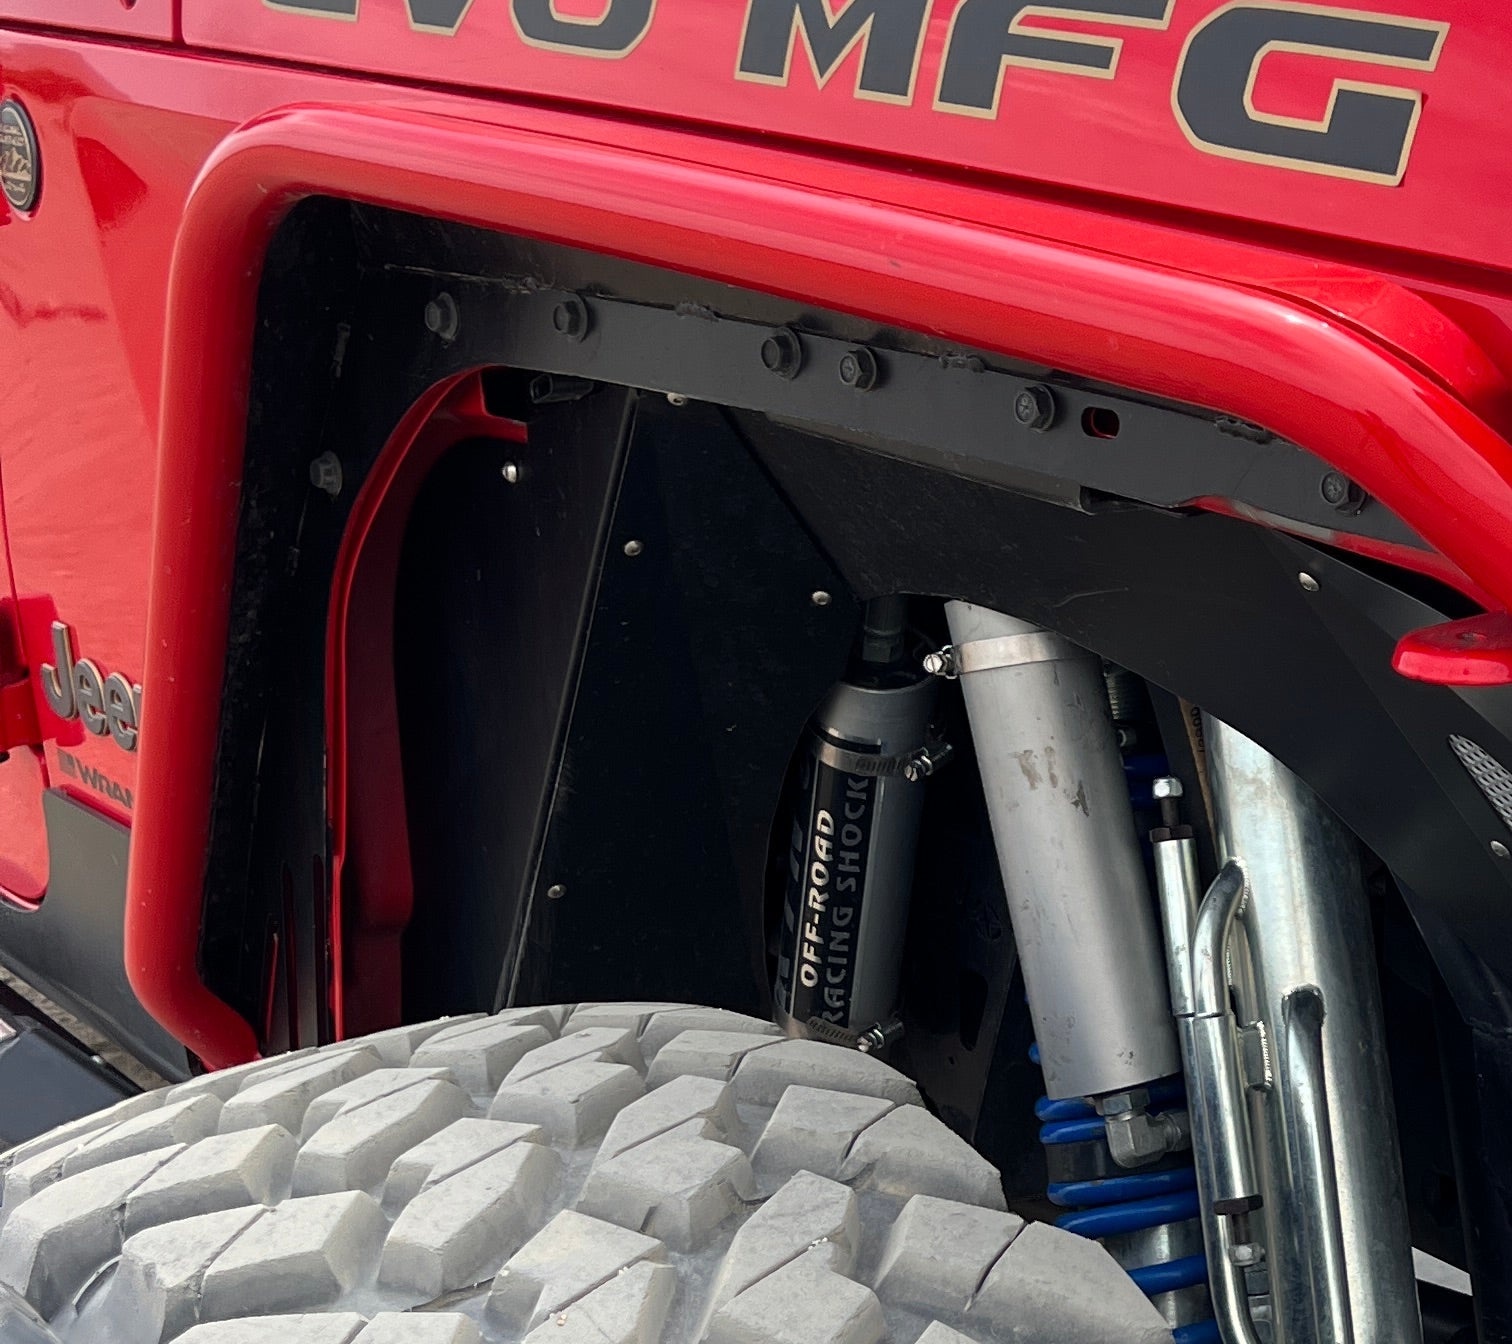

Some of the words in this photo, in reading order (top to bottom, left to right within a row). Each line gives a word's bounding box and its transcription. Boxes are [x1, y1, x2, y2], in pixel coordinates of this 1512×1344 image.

[41, 619, 143, 752] Jee
[800, 809, 835, 989] OFF-ROAD
[836, 774, 869, 893] SHOCK
